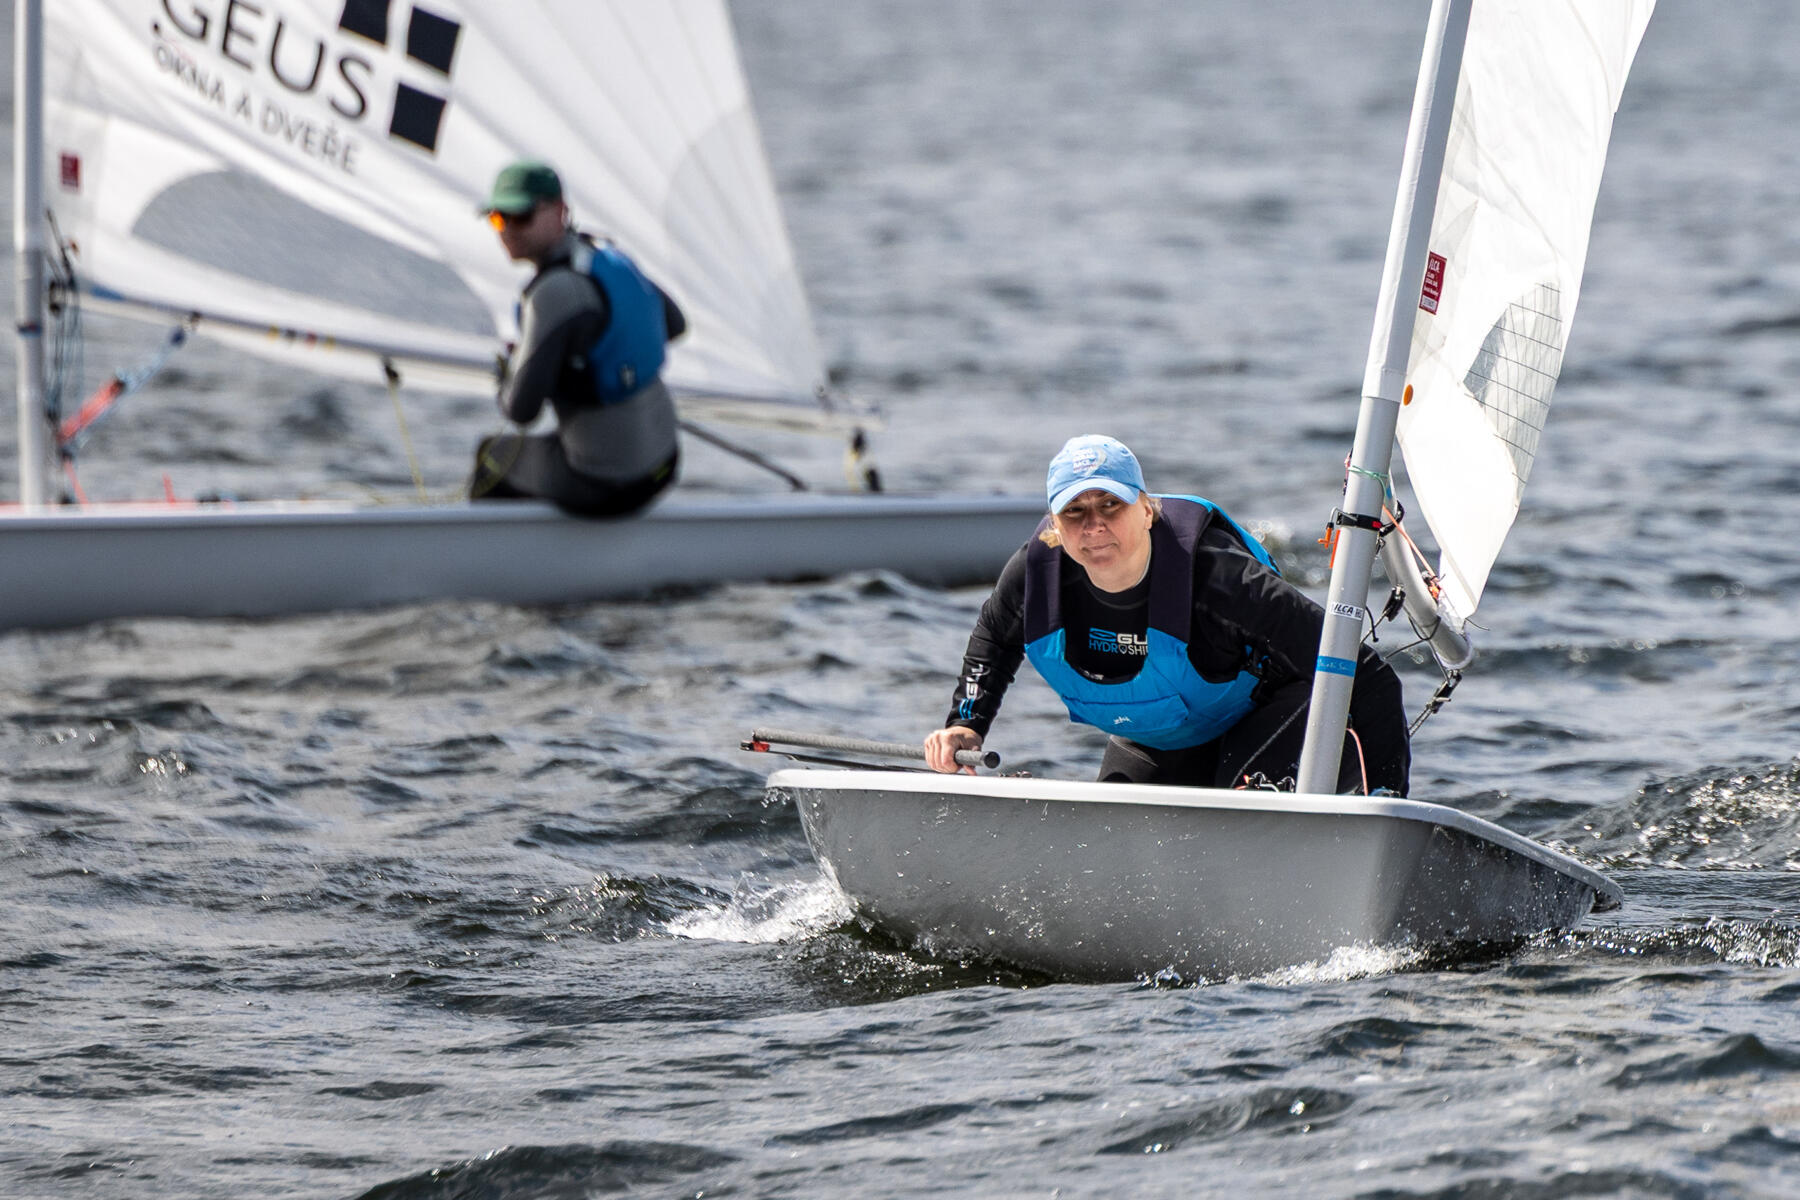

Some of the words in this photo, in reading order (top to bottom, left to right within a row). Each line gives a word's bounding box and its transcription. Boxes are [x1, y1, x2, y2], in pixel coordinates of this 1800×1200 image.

[153, 45, 225, 107] OKNA
[235, 93, 252, 123] A
[1334, 603, 1354, 614] ILCA
[1117, 633, 1148, 645] GU
